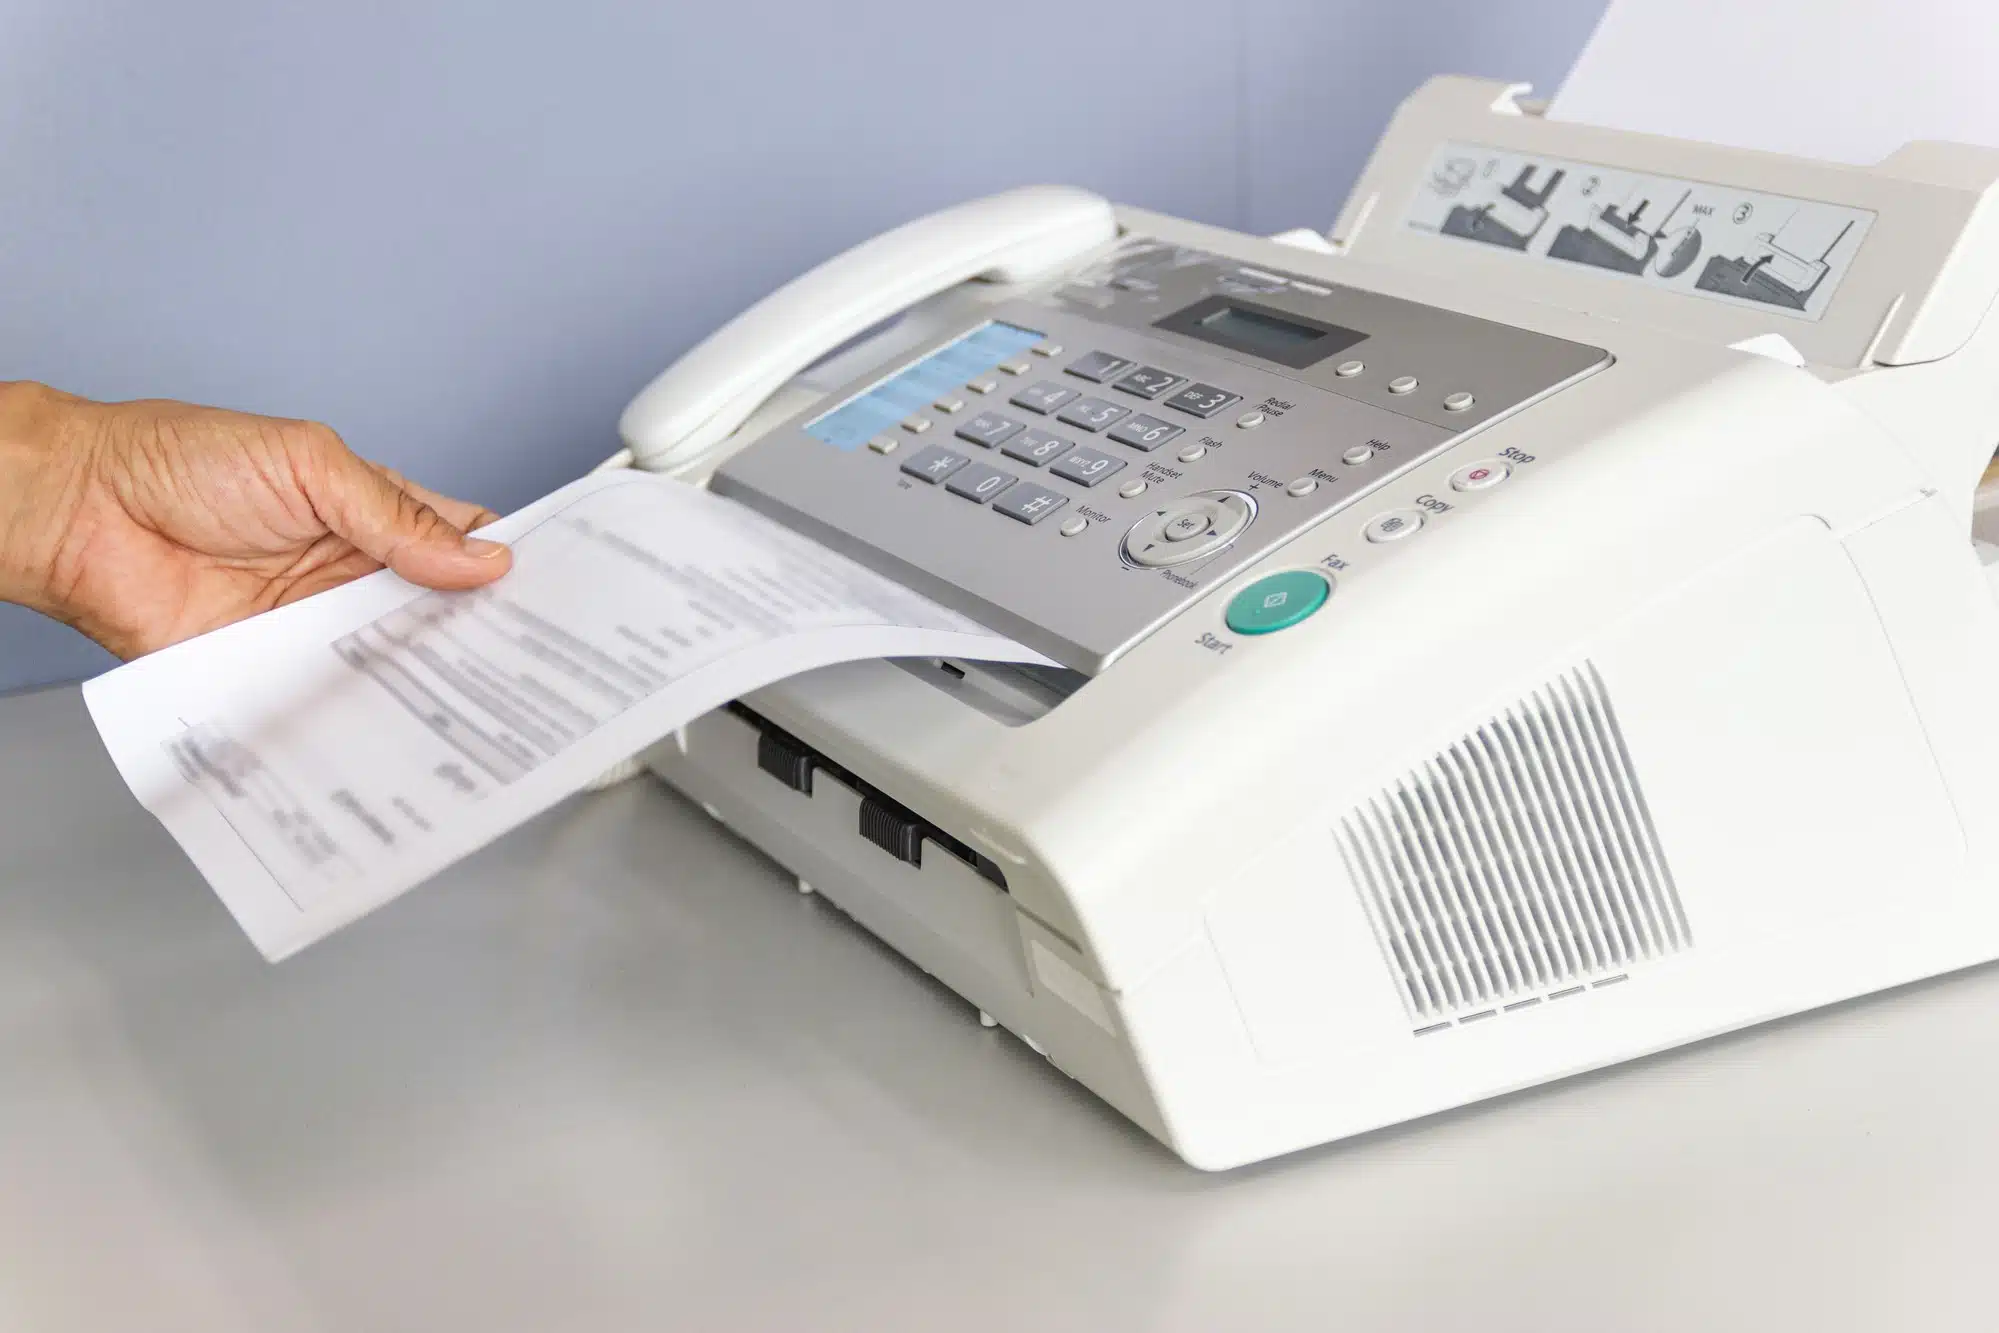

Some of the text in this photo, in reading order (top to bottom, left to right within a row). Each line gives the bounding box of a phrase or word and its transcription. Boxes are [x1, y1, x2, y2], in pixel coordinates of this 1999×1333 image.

[1098, 360, 1121, 375] 1
[1146, 376, 1174, 393] 2
[1043, 390, 1067, 405] 4
[1183, 389, 1227, 409] DEF 3
[1264, 397, 1297, 411] Redial
[1090, 407, 1119, 422] 5
[984, 420, 1012, 437] 7
[1142, 426, 1170, 441] 6
[1033, 440, 1060, 456] 8
[1198, 436, 1223, 449] Flash
[1365, 438, 1391, 451] Help
[1497, 446, 1536, 465] Stop
[1082, 460, 1109, 475] 9
[1146, 461, 1185, 480] Handset
[1308, 468, 1340, 483] Menu
[976, 476, 1001, 492] 0
[1140, 470, 1165, 484] Mute
[1247, 471, 1284, 489] Volume
[1021, 496, 1052, 513] #
[1414, 493, 1456, 515] Copy
[1075, 505, 1112, 524] Monitor
[1177, 518, 1196, 530] Set
[1321, 553, 1352, 572] Fax
[1195, 632, 1233, 655] Start
